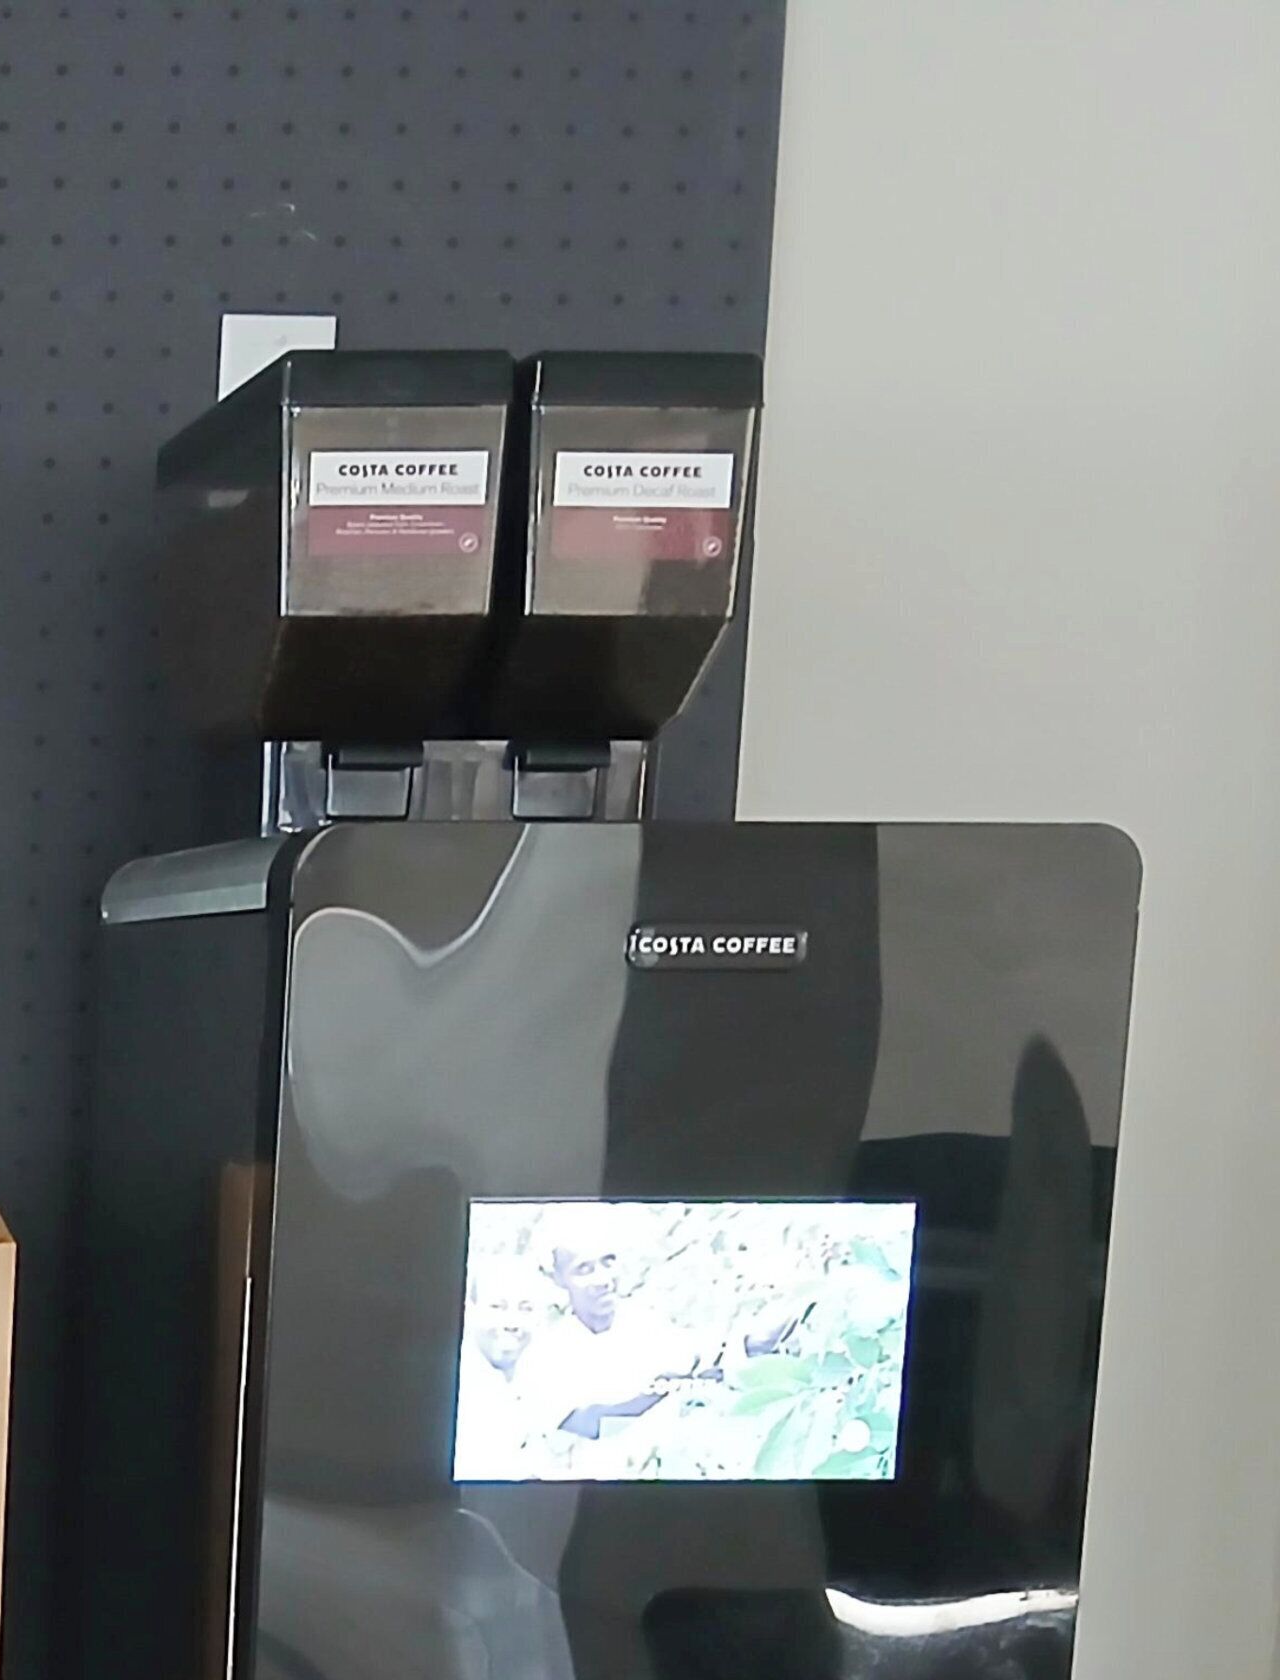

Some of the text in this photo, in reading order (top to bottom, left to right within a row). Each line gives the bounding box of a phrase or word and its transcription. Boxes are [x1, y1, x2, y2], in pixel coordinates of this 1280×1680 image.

[338, 464, 458, 478] COSTA COFFEE
[583, 465, 702, 478] COSTA COFFEE
[639, 937, 795, 955] COSTA COFFEE
